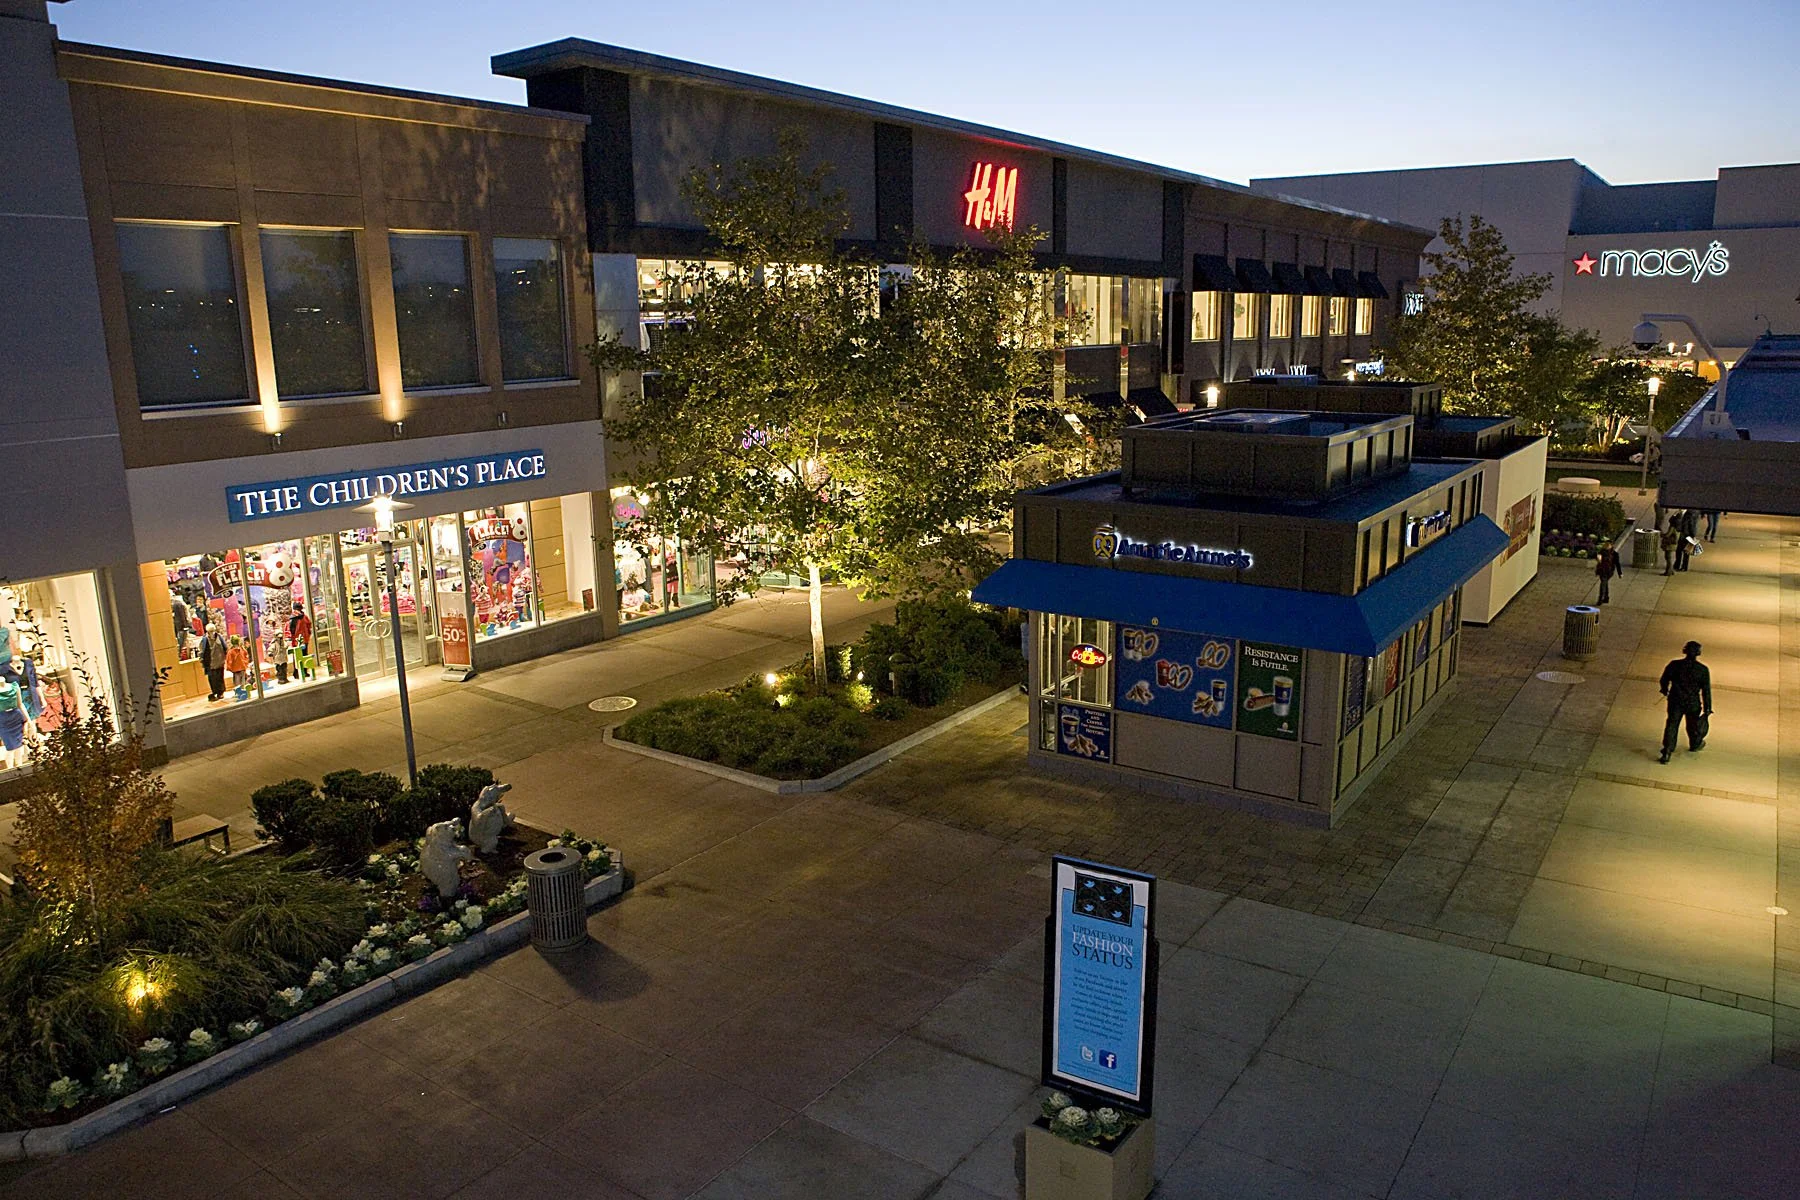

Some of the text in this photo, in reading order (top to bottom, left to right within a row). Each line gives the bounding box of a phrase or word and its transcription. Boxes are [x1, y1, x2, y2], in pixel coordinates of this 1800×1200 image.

[964, 162, 1018, 232] H&M
[236, 455, 547, 517] THE CHILDREN'S PLACE
[1244, 646, 1299, 663] RESISTANCE
[1072, 924, 1133, 946] UPDATE YOUR
[1072, 932, 1133, 957] FASHION
[1072, 942, 1133, 970] STATUS
